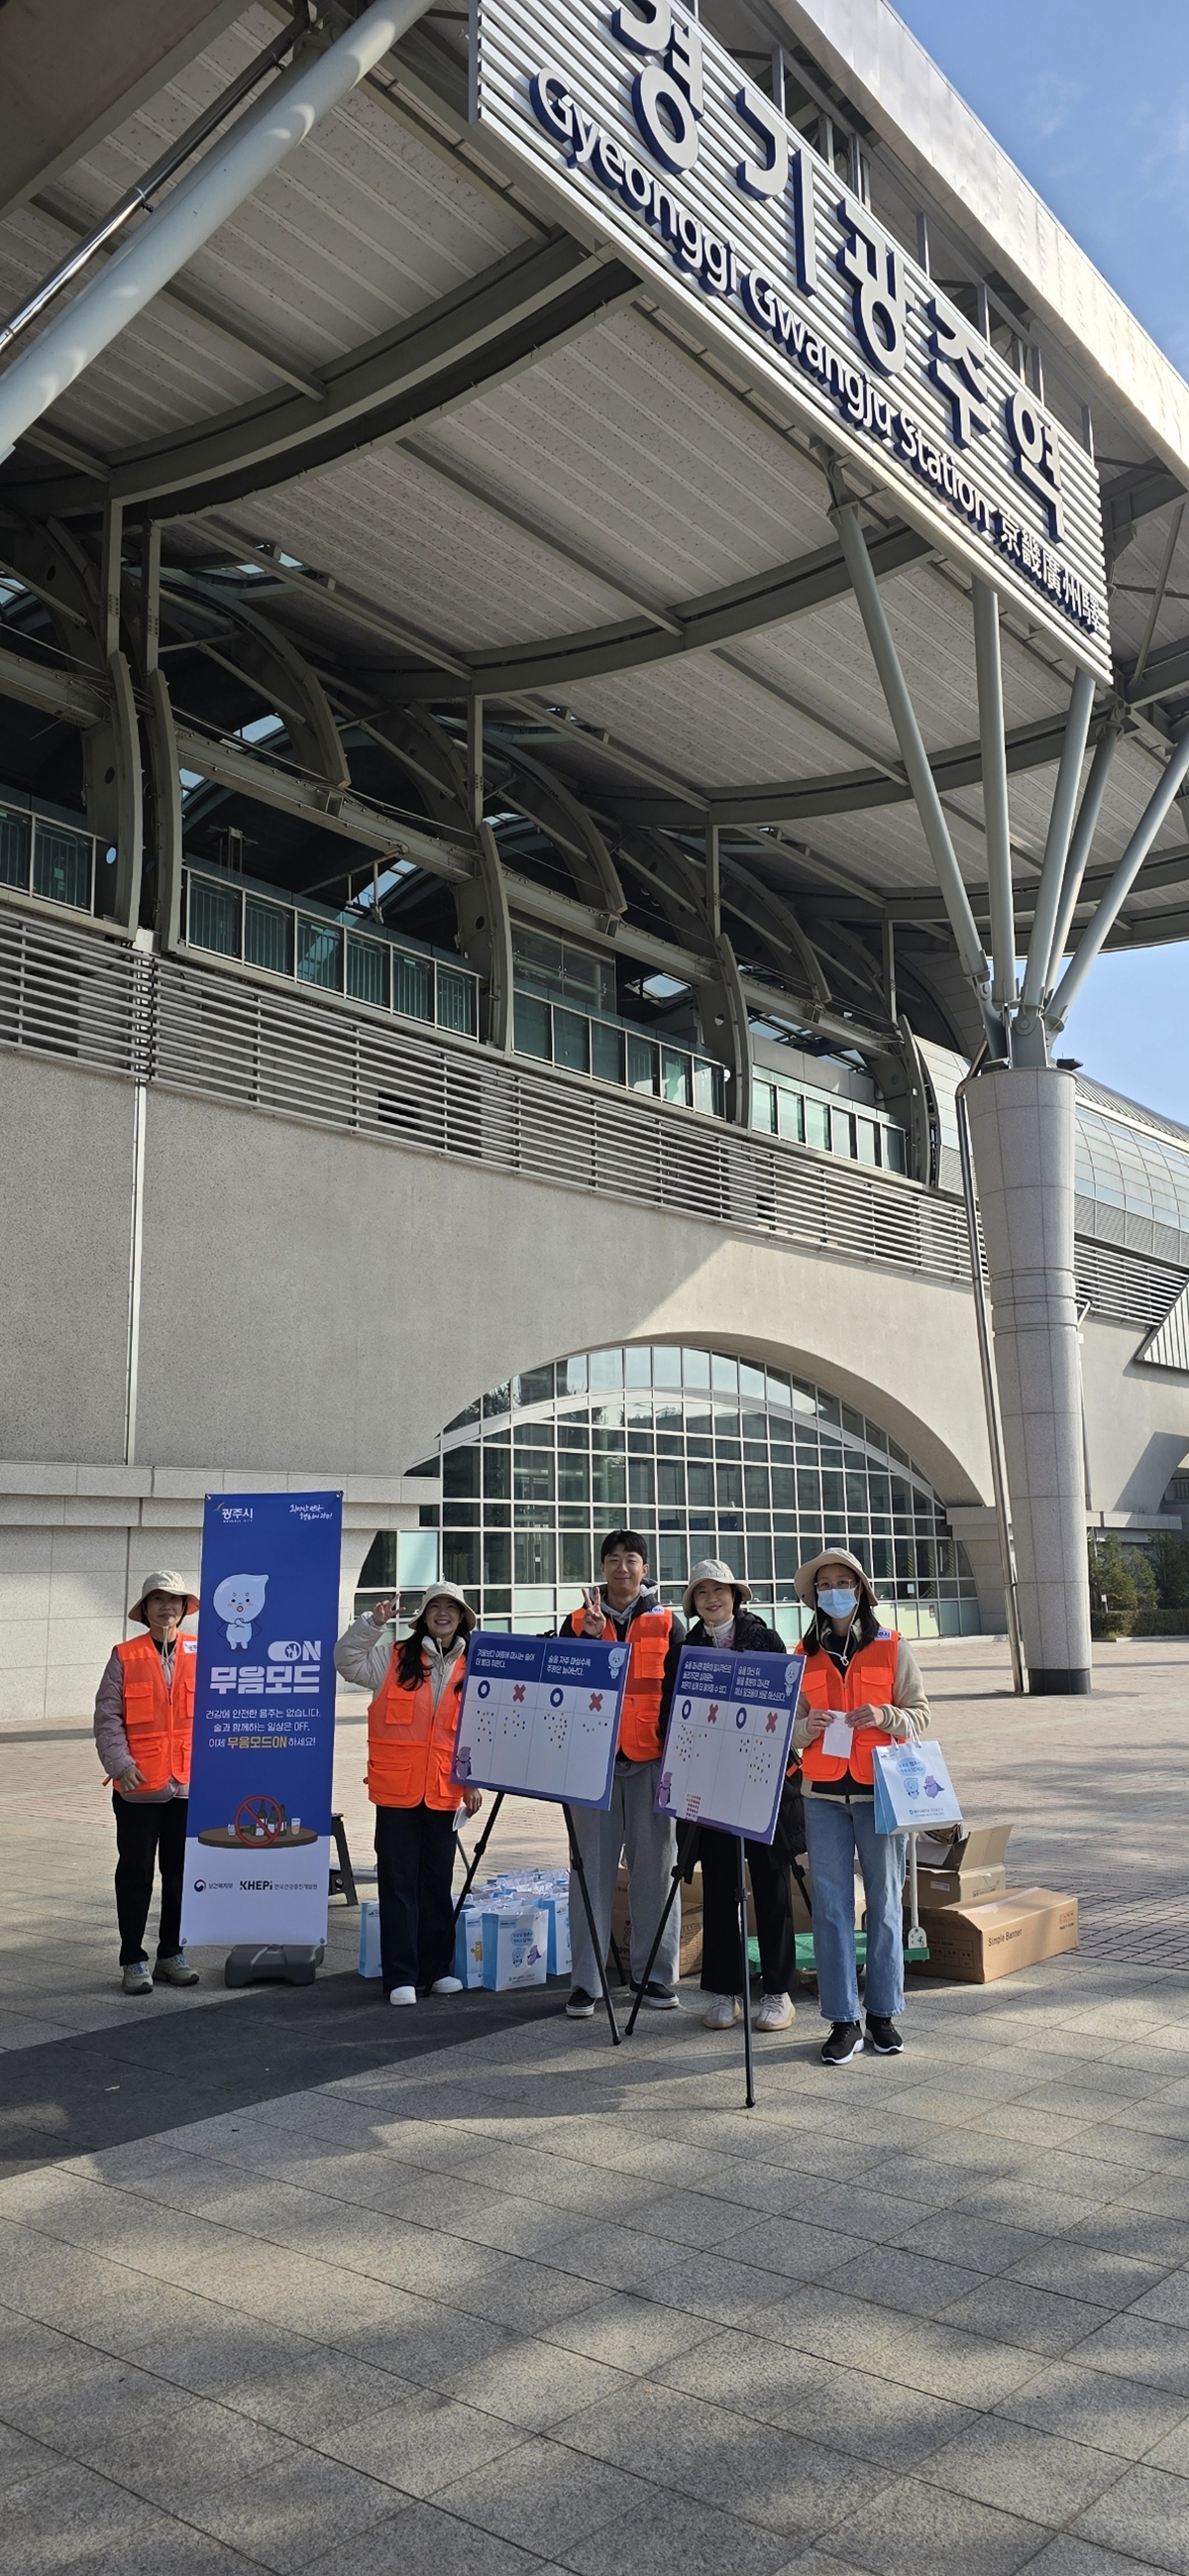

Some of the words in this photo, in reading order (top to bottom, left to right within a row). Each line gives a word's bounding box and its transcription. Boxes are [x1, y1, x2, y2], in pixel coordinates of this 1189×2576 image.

[610, 0, 1064, 543] 경기광주역
[529, 67, 737, 296] Gyeonggi
[741, 268, 893, 440] Gwangju
[895, 408, 992, 532] Station
[221, 1508, 254, 1520] 광주시
[548, 1655, 559, 1664] 술을
[570, 1657, 591, 1667] 마실수록
[210, 1665, 321, 1694] 무음모드
[206, 1710, 230, 1719] 건강에
[232, 1709, 258, 1719] 안전한
[260, 1709, 283, 1718] 음주는
[285, 1709, 321, 1718] 없습니다.
[214, 1724, 230, 1733] 술과
[232, 1723, 265, 1732] 함께하는
[268, 1723, 291, 1732] 일상은
[293, 1722, 310, 1731] OFF.
[208, 1738, 226, 1747] 이제
[227, 1736, 287, 1748] 무음모드ON
[288, 1736, 316, 1746] 하세요!
[989, 1935, 1005, 1947] Simple
[1006, 1929, 1023, 1941] Banner
